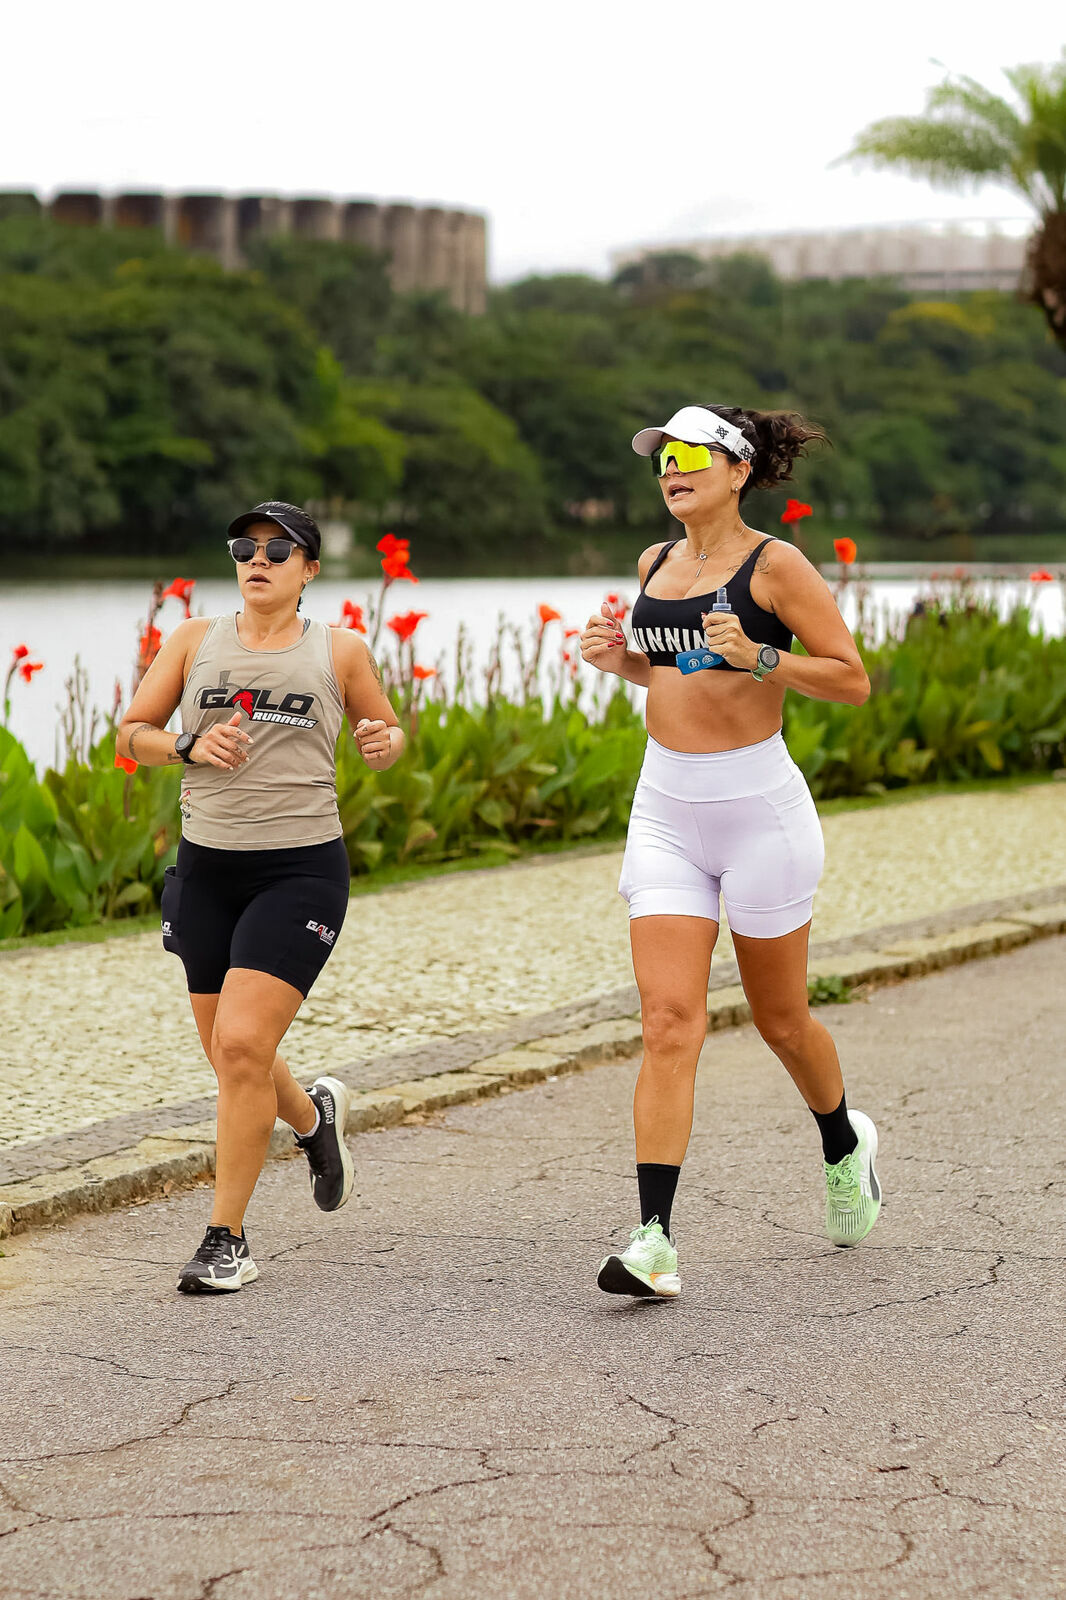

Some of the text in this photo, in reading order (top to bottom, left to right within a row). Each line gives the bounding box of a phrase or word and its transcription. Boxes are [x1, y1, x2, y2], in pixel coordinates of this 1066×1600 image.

[200, 688, 315, 716] GALO
[252, 711, 317, 729] RUNNERS
[305, 919, 336, 940] GALO
[319, 1094, 335, 1125] CORRE
